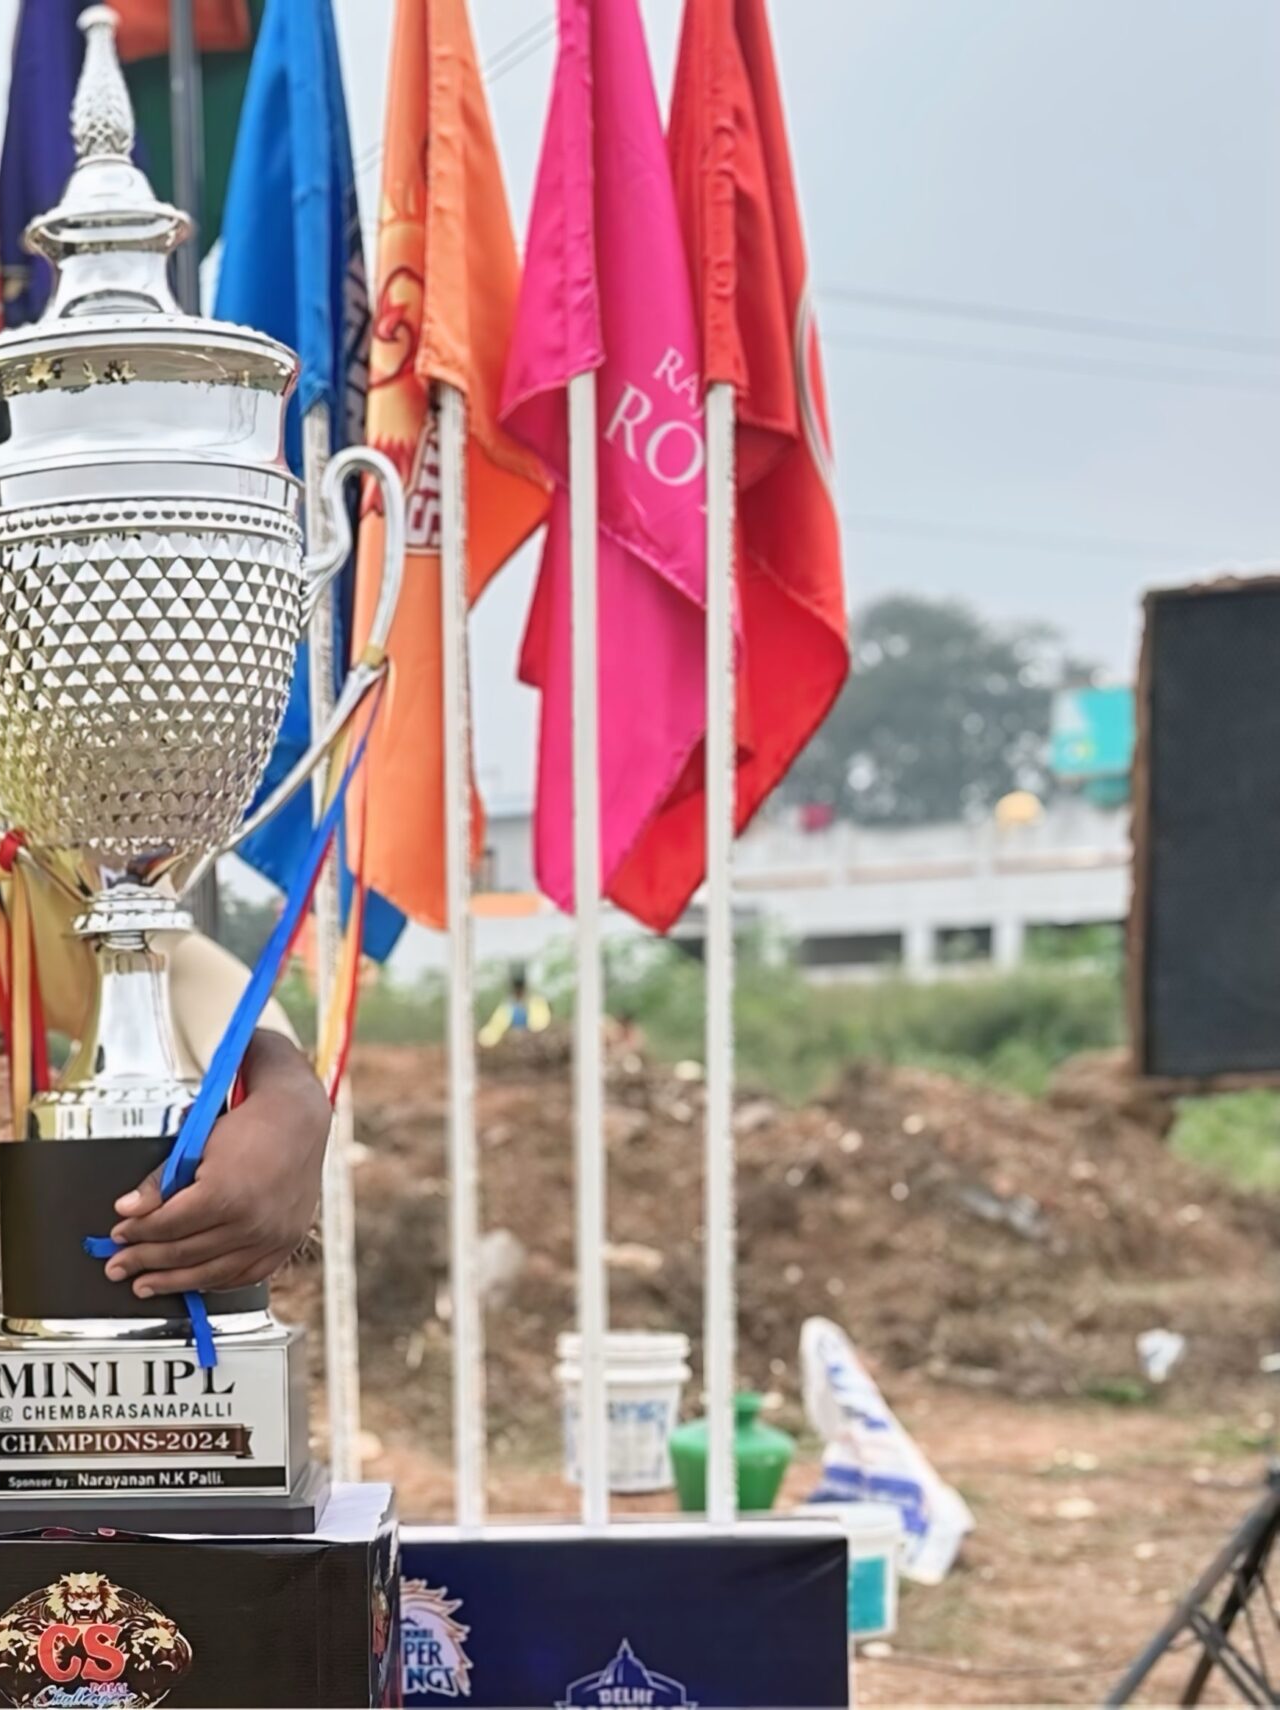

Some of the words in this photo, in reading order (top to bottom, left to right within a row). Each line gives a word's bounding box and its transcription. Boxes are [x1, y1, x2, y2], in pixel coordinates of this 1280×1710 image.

[604, 383, 705, 488] RO
[142, 1359, 237, 1396] IPL
[22, 1402, 233, 1422] CHEMBARASANAPALLI
[0, 1431, 231, 1453] CHAMPIONS-2024
[7, 1476, 52, 1488] Sponsor
[77, 1472, 156, 1489] Narayanan
[37, 1623, 127, 1682] CS
[403, 1640, 443, 1666] PER
[406, 1667, 455, 1693] NGS
[597, 1688, 655, 1705] DELHI
